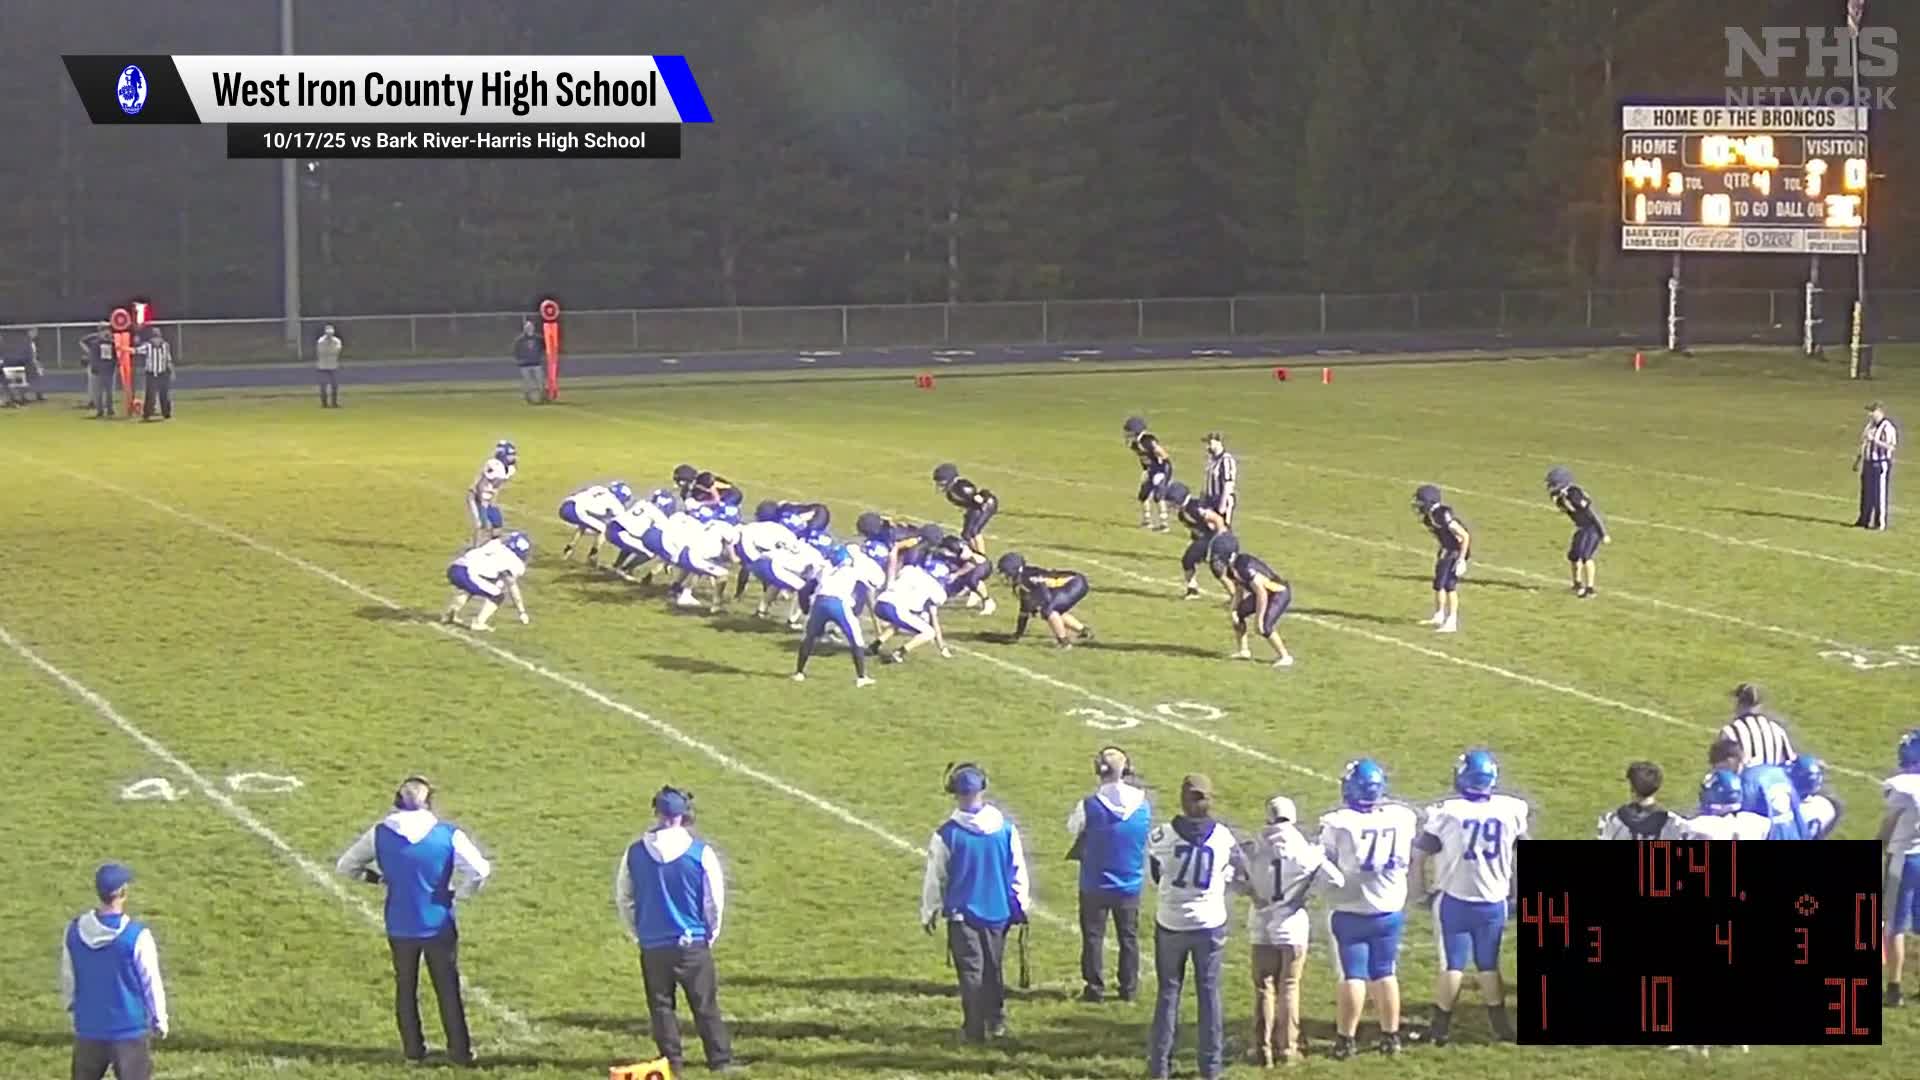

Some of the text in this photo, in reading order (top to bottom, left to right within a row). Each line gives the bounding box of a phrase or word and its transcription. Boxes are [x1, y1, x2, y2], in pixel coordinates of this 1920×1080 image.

[1653, 110, 1836, 126] HOME OF THE BRONCOS
[1631, 139, 1677, 154] HOME
[1724, 172, 1750, 189] QTR
[1647, 200, 1682, 215] DOWN
[1733, 201, 1769, 216] TO GO
[1776, 201, 1824, 217] BALL ON
[1463, 819, 1501, 860] 79
[1360, 828, 1397, 872] 77
[1172, 845, 1215, 890] 70
[1271, 858, 1284, 901] 1
